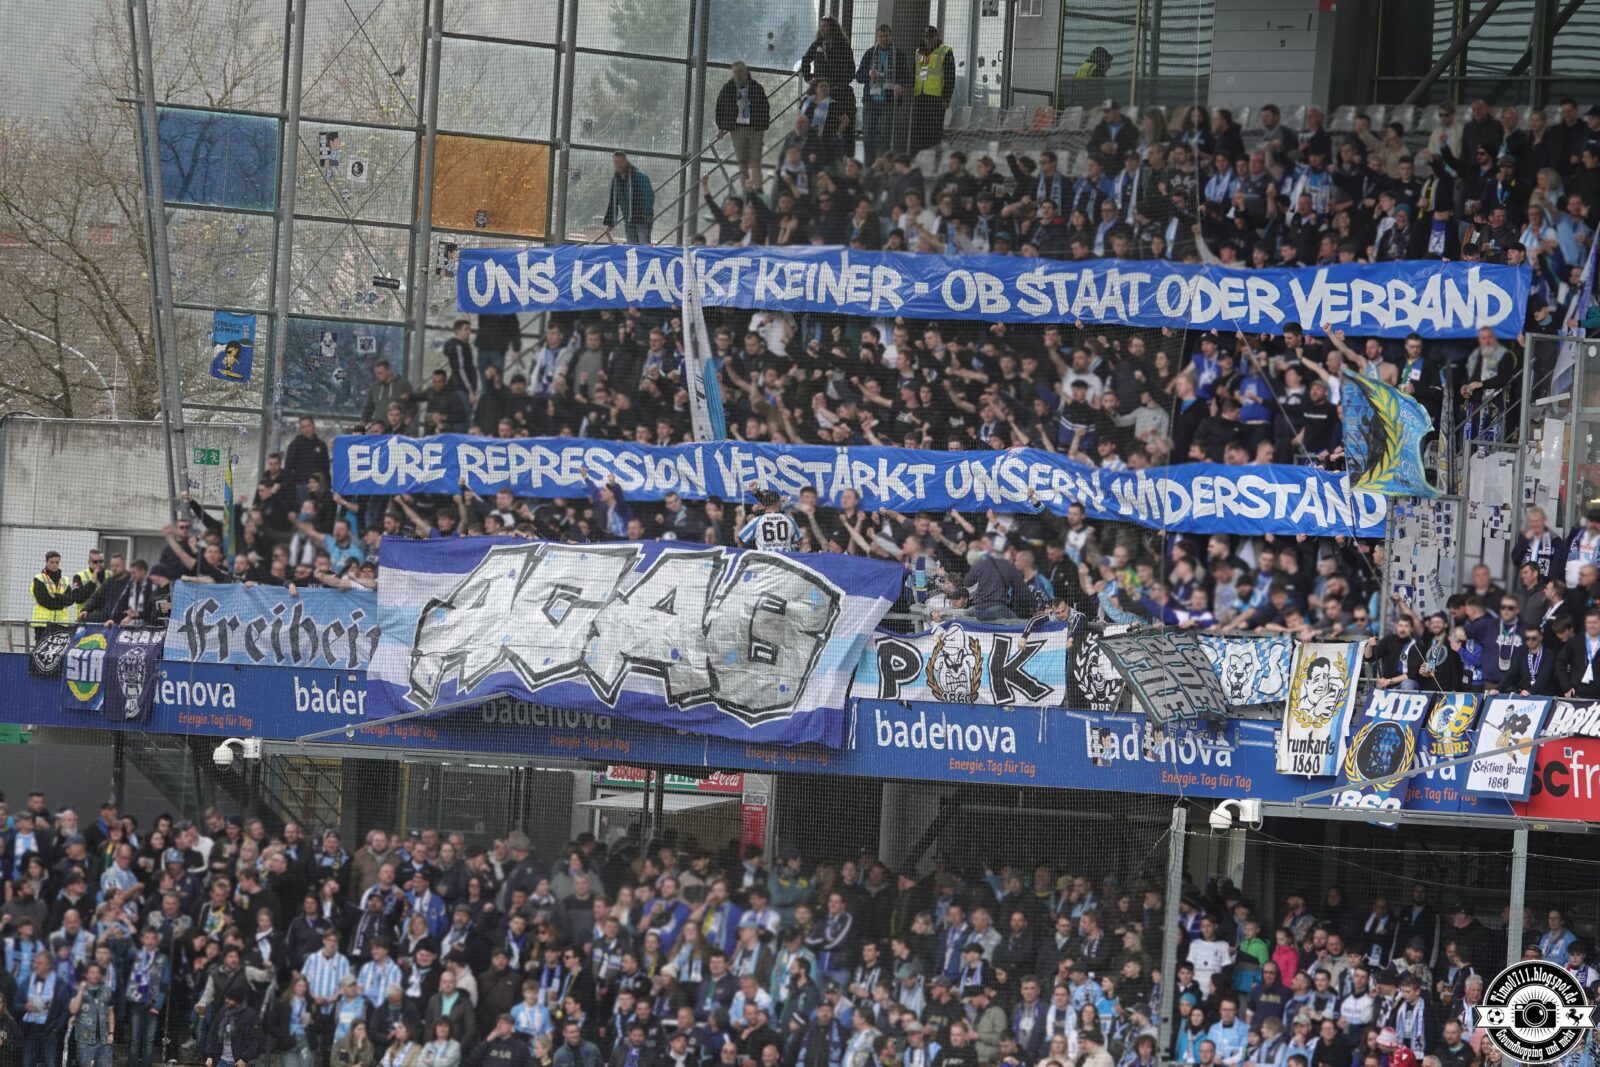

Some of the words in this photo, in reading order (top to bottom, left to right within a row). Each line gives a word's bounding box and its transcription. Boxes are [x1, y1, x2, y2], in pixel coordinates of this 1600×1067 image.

[467, 251, 558, 309] UNS
[754, 250, 905, 312] KEINER
[941, 268, 1009, 315] OB
[1017, 267, 1153, 321] STAAT
[1156, 272, 1285, 326] ODER
[1289, 266, 1513, 331] VERBAND
[347, 437, 447, 485] EURE
[457, 442, 706, 497] REPRESSION
[714, 446, 936, 502] VERSTÄRKT
[945, 455, 1104, 511] UNSERN
[1110, 469, 1388, 530] WIDERSTAND
[762, 520, 788, 542] 60
[875, 636, 923, 699] P
[989, 633, 1054, 705] K
[1365, 688, 1429, 721] MIB
[210, 714, 225, 728] Tag
[226, 714, 238, 726] für
[239, 717, 253, 731] Tag
[875, 708, 1016, 754] badenova
[1429, 740, 1470, 756] JAHRE
[949, 758, 985, 773] Energie.
[987, 759, 1003, 775] Tag
[1004, 759, 1018, 773] für
[1020, 761, 1035, 777] Tag
[1293, 754, 1320, 774] 1860
[1473, 760, 1504, 773] Sektion
[1162, 771, 1199, 786] Energie.
[1201, 773, 1217, 789] Tag
[1219, 773, 1233, 786] für
[1235, 775, 1252, 792] Tag
[1487, 776, 1509, 790] 1860
[1424, 787, 1441, 803] Tag
[1443, 786, 1459, 801] für
